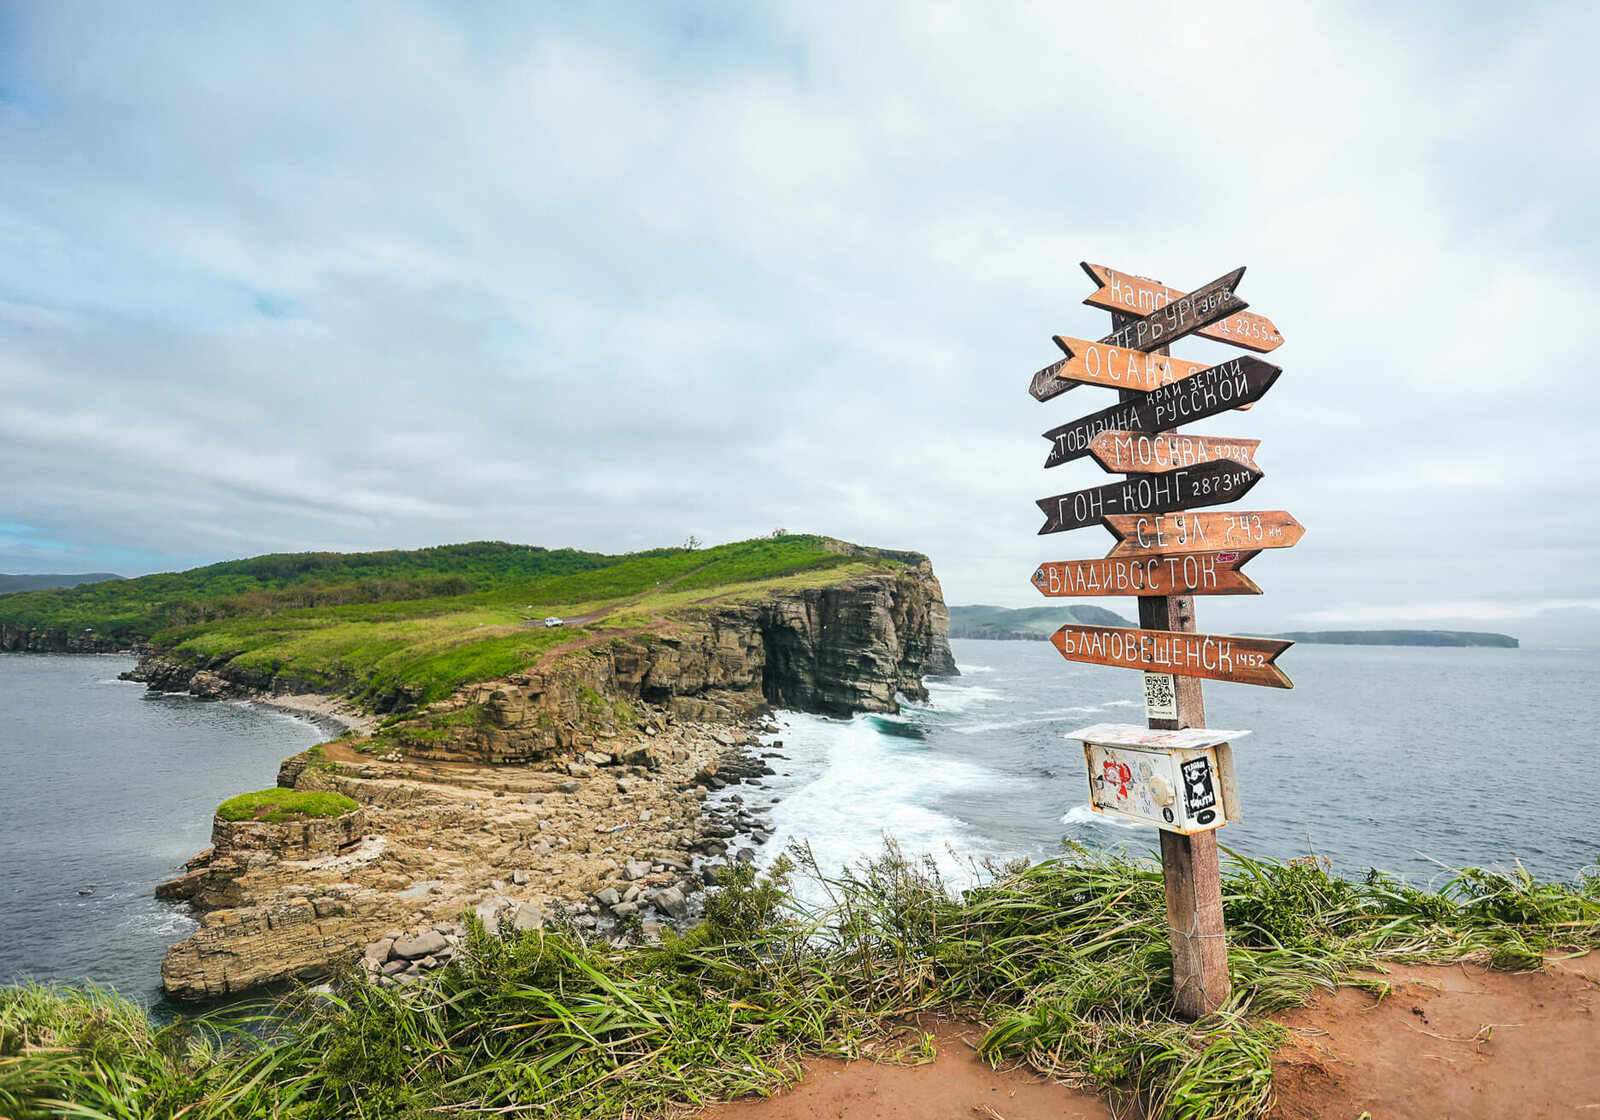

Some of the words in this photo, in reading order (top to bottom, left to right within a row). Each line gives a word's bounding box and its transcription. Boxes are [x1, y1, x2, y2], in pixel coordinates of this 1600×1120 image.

[1085, 346, 1175, 387] ОСАКА
[1188, 359, 1241, 391] ЗЕМЛИ
[1056, 406, 1142, 456] ТОБИЗИНА
[1115, 435, 1209, 467] МОСКВА
[1214, 444, 1250, 466] 9288
[1058, 471, 1189, 526] ГОН-КОНГ
[1136, 515, 1207, 549] СЕУЛ
[1223, 515, 1264, 542] 743
[1048, 555, 1217, 594] ВЛАДИВОСТОК
[1065, 629, 1233, 673] БЛАГОВЕЩЕНСК
[1235, 653, 1266, 667] 1452
